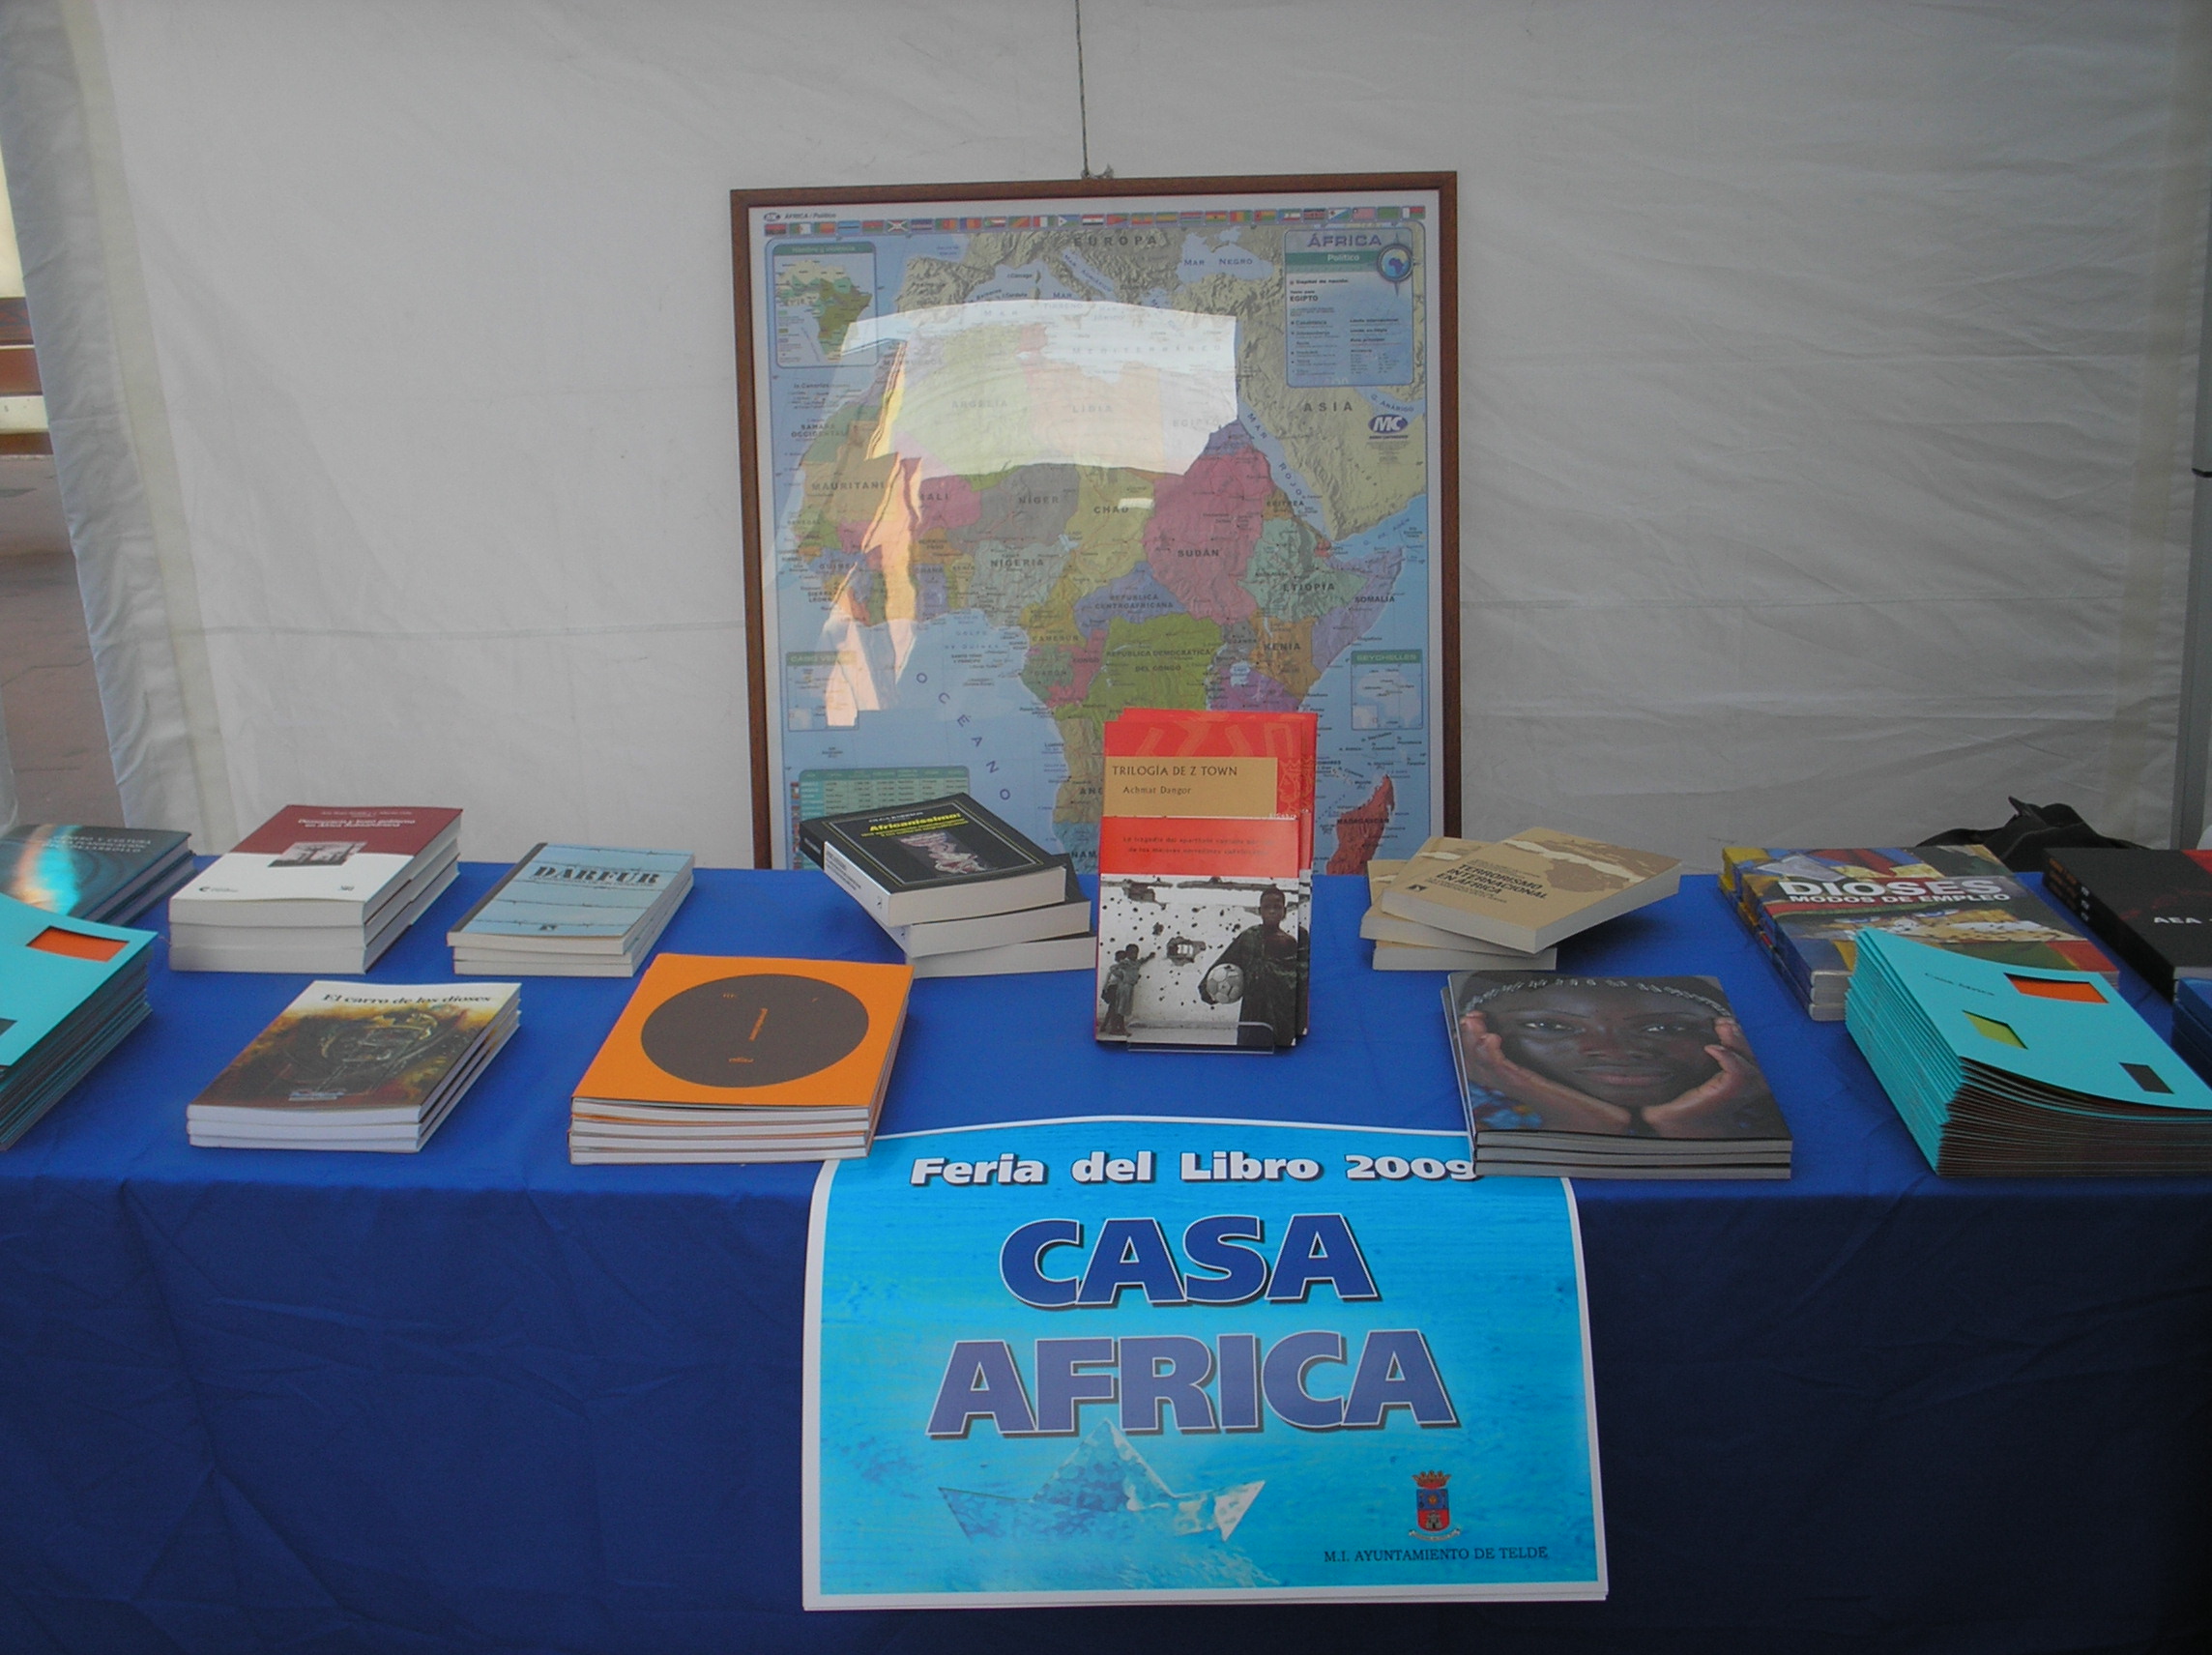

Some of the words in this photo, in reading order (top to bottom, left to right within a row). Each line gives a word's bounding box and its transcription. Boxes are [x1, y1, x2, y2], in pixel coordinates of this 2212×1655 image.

[1073, 235, 1157, 247] EUROPA
[1307, 233, 1382, 247] ÁFRICA
[1219, 257, 1253, 266] NEGRO
[1303, 400, 1353, 413] ASIA
[1278, 462, 1302, 497] ROJO
[1177, 547, 1219, 558] SUDÁN
[990, 558, 1044, 567] NIGERIA
[1094, 601, 1174, 610] CENTROAFRICANA
[1264, 642, 1301, 652] KENIA
[1356, 653, 1417, 661] SEYCHELLES
[1113, 765, 1169, 776] TRILOGÍA
[1173, 767, 1185, 776] DE
[1190, 767, 1197, 776] Z
[1200, 767, 1237, 776] TOWN
[1160, 786, 1192, 796] Dangor
[533, 866, 660, 884] DARFUR
[1459, 863, 1543, 889] TERRORISMO
[1446, 868, 1547, 899] INTERNACIONAL
[1778, 879, 2003, 898] DIOSES
[1790, 895, 1877, 904] MODOS
[1881, 895, 1914, 904] DE
[1918, 892, 2011, 903] EMPLEO
[910, 1152, 1047, 1187] Feria
[1070, 1149, 1155, 1184] del
[1179, 1149, 1323, 1182] Libro
[1345, 1154, 1477, 1182] 2009
[999, 1212, 1381, 1307] CASA
[926, 1329, 1460, 1438] AFRICA
[1324, 1551, 1351, 1563] M.I.
[1354, 1548, 1470, 1562] AYUNTAMIENTO
[1474, 1548, 1496, 1560] DE
[1499, 1547, 1549, 1559] TELDE
